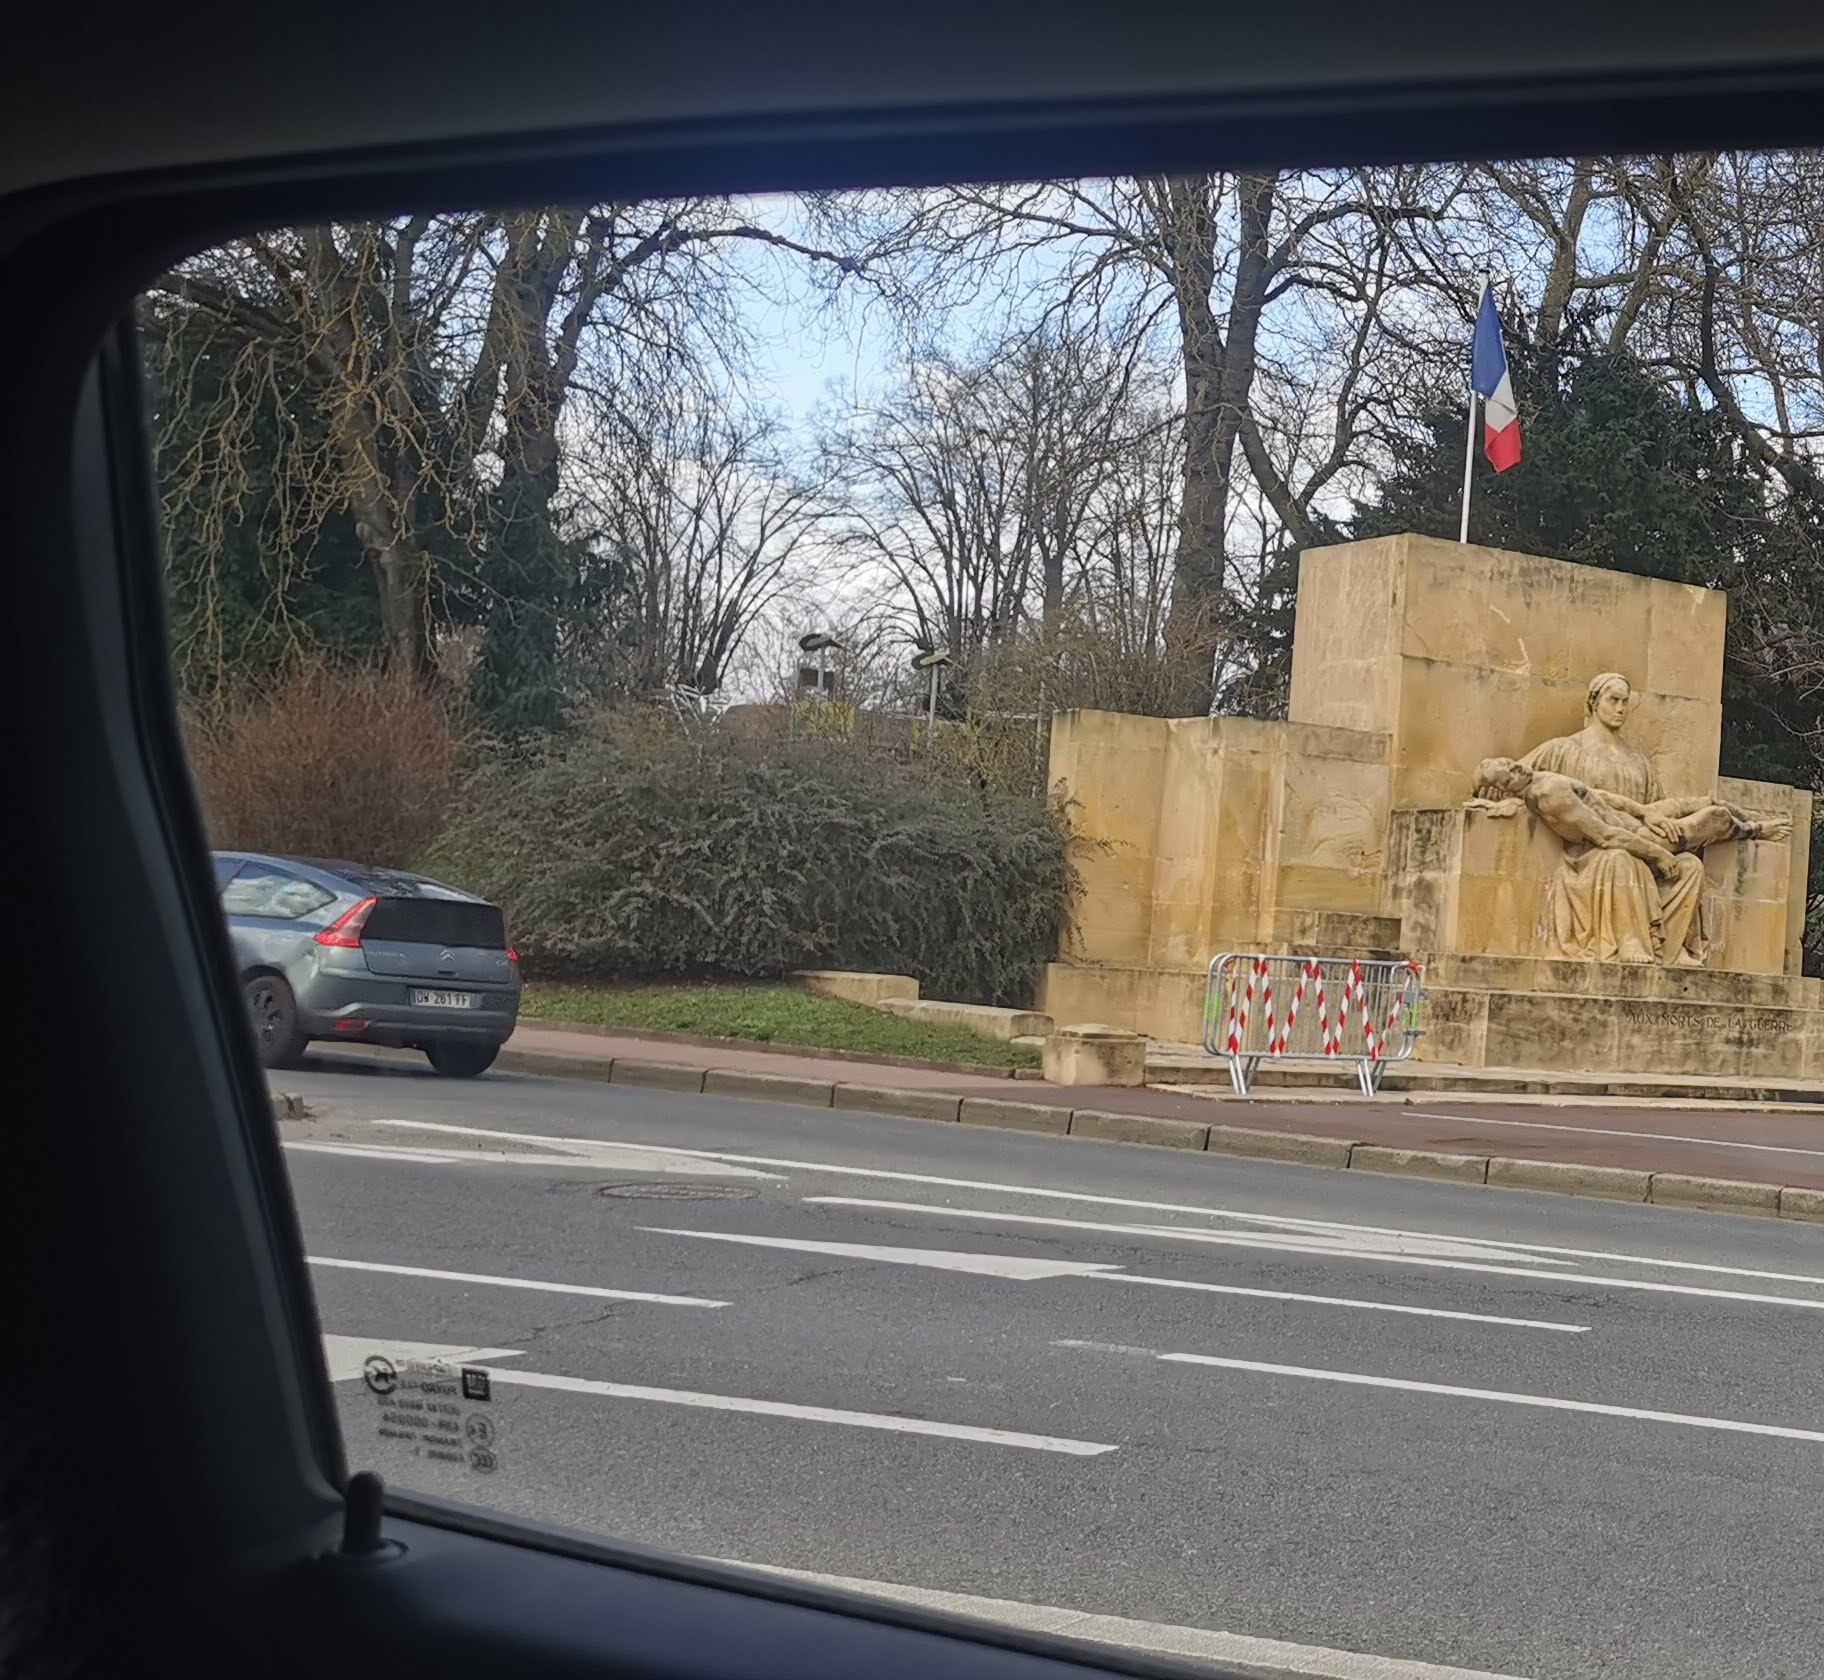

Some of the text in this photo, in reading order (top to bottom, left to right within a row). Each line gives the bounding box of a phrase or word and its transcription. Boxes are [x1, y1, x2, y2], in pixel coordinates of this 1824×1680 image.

[1627, 1012, 1793, 1033] AUX MORTS DE LA GUERRE
